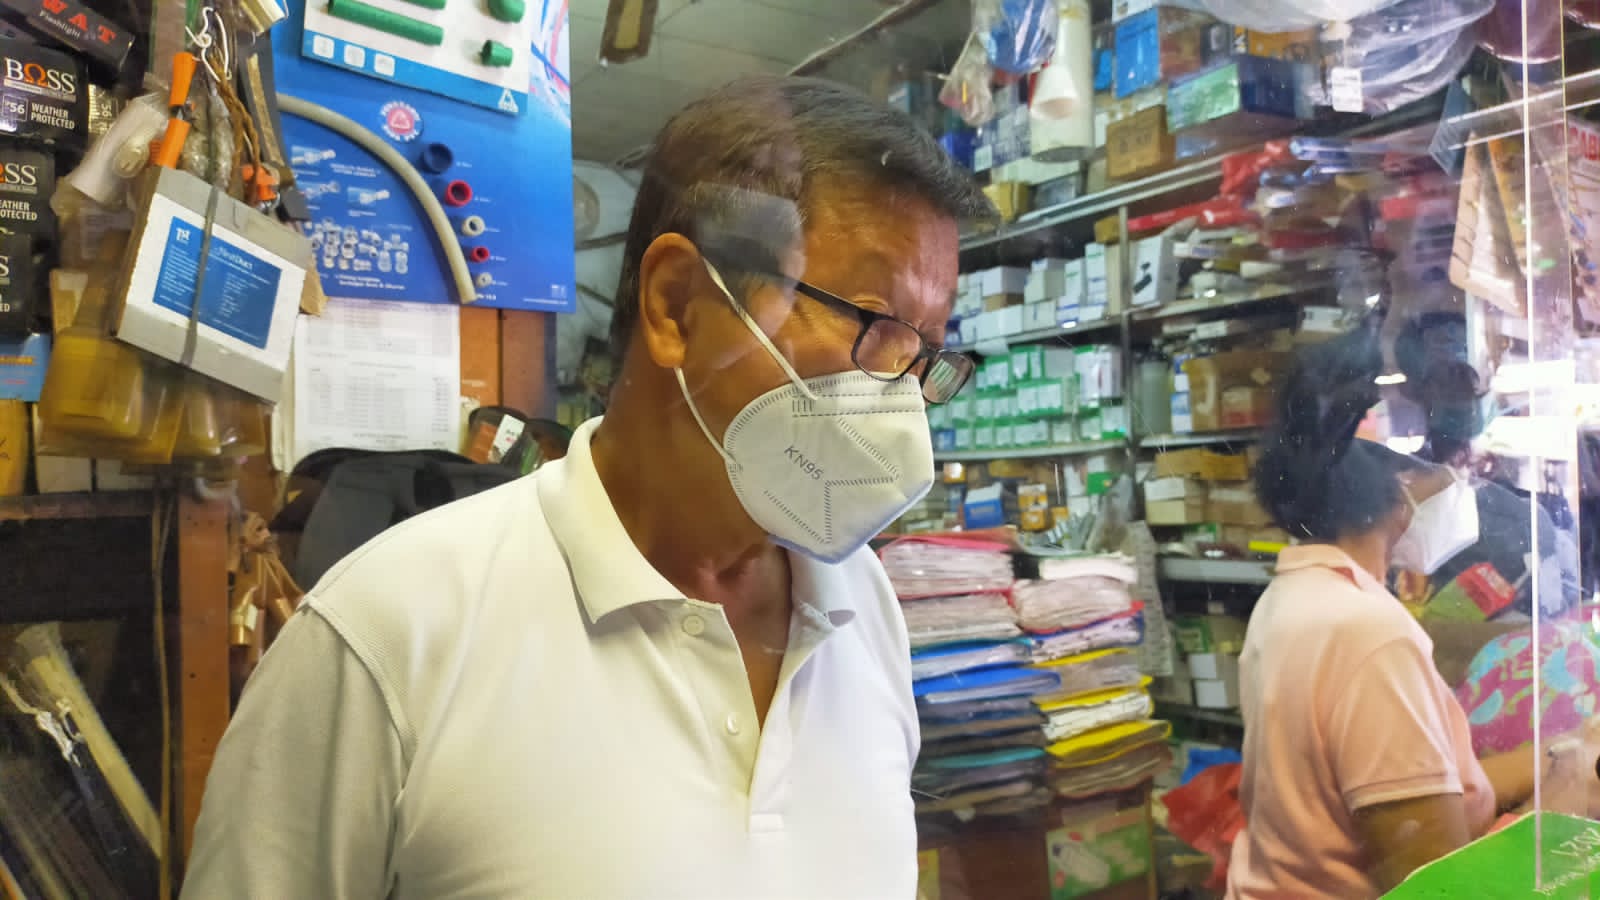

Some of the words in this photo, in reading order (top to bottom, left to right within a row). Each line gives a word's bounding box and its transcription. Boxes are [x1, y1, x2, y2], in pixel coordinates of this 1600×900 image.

[40, 9, 80, 38] Flashlight
[30, 111, 76, 130] PROTECTED
[31, 102, 69, 117] WEATHER
[783, 445, 825, 480] KN95
